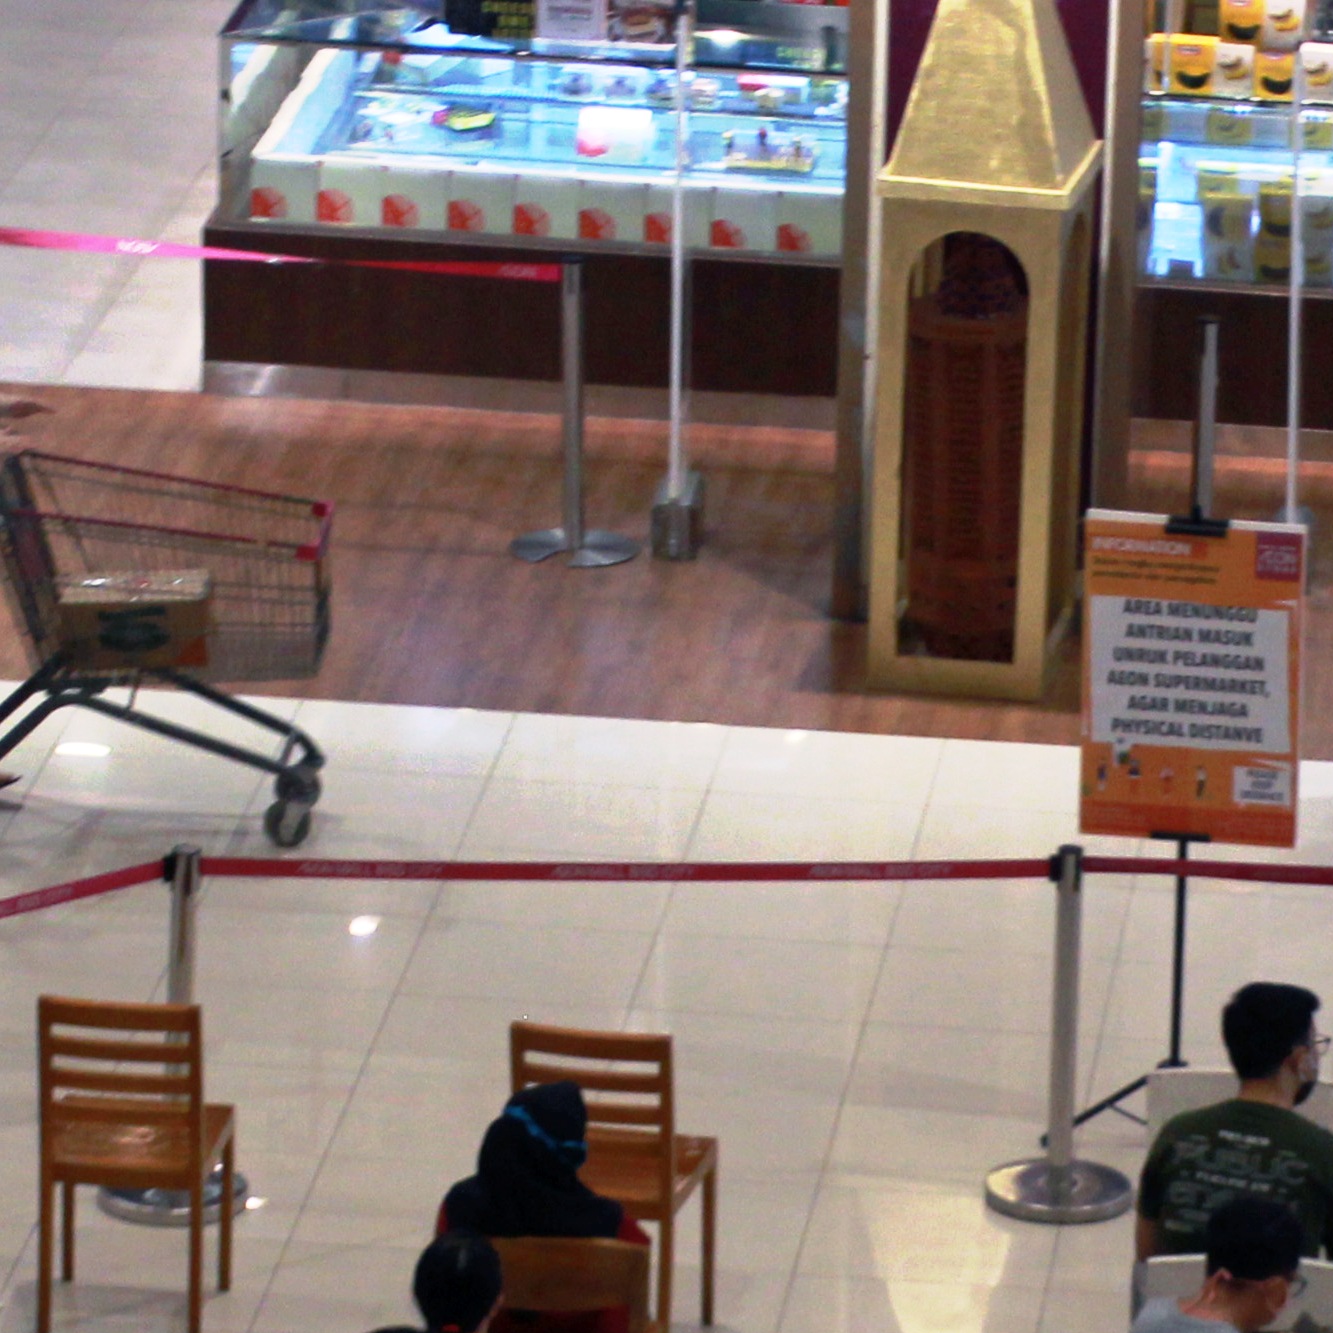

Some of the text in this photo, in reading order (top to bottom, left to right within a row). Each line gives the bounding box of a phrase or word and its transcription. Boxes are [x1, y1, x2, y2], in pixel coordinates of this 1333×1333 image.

[1123, 598, 1256, 622] AREA MENUNGGU
[1124, 622, 1253, 646] ANTRIAN MASUK
[1173, 650, 1264, 671] PELANGGAN
[1107, 669, 1270, 697] AEON SUPERMARKET,
[1127, 694, 1247, 717] AGAR MENJAGA
[1111, 717, 1184, 736] PHYSICAL
